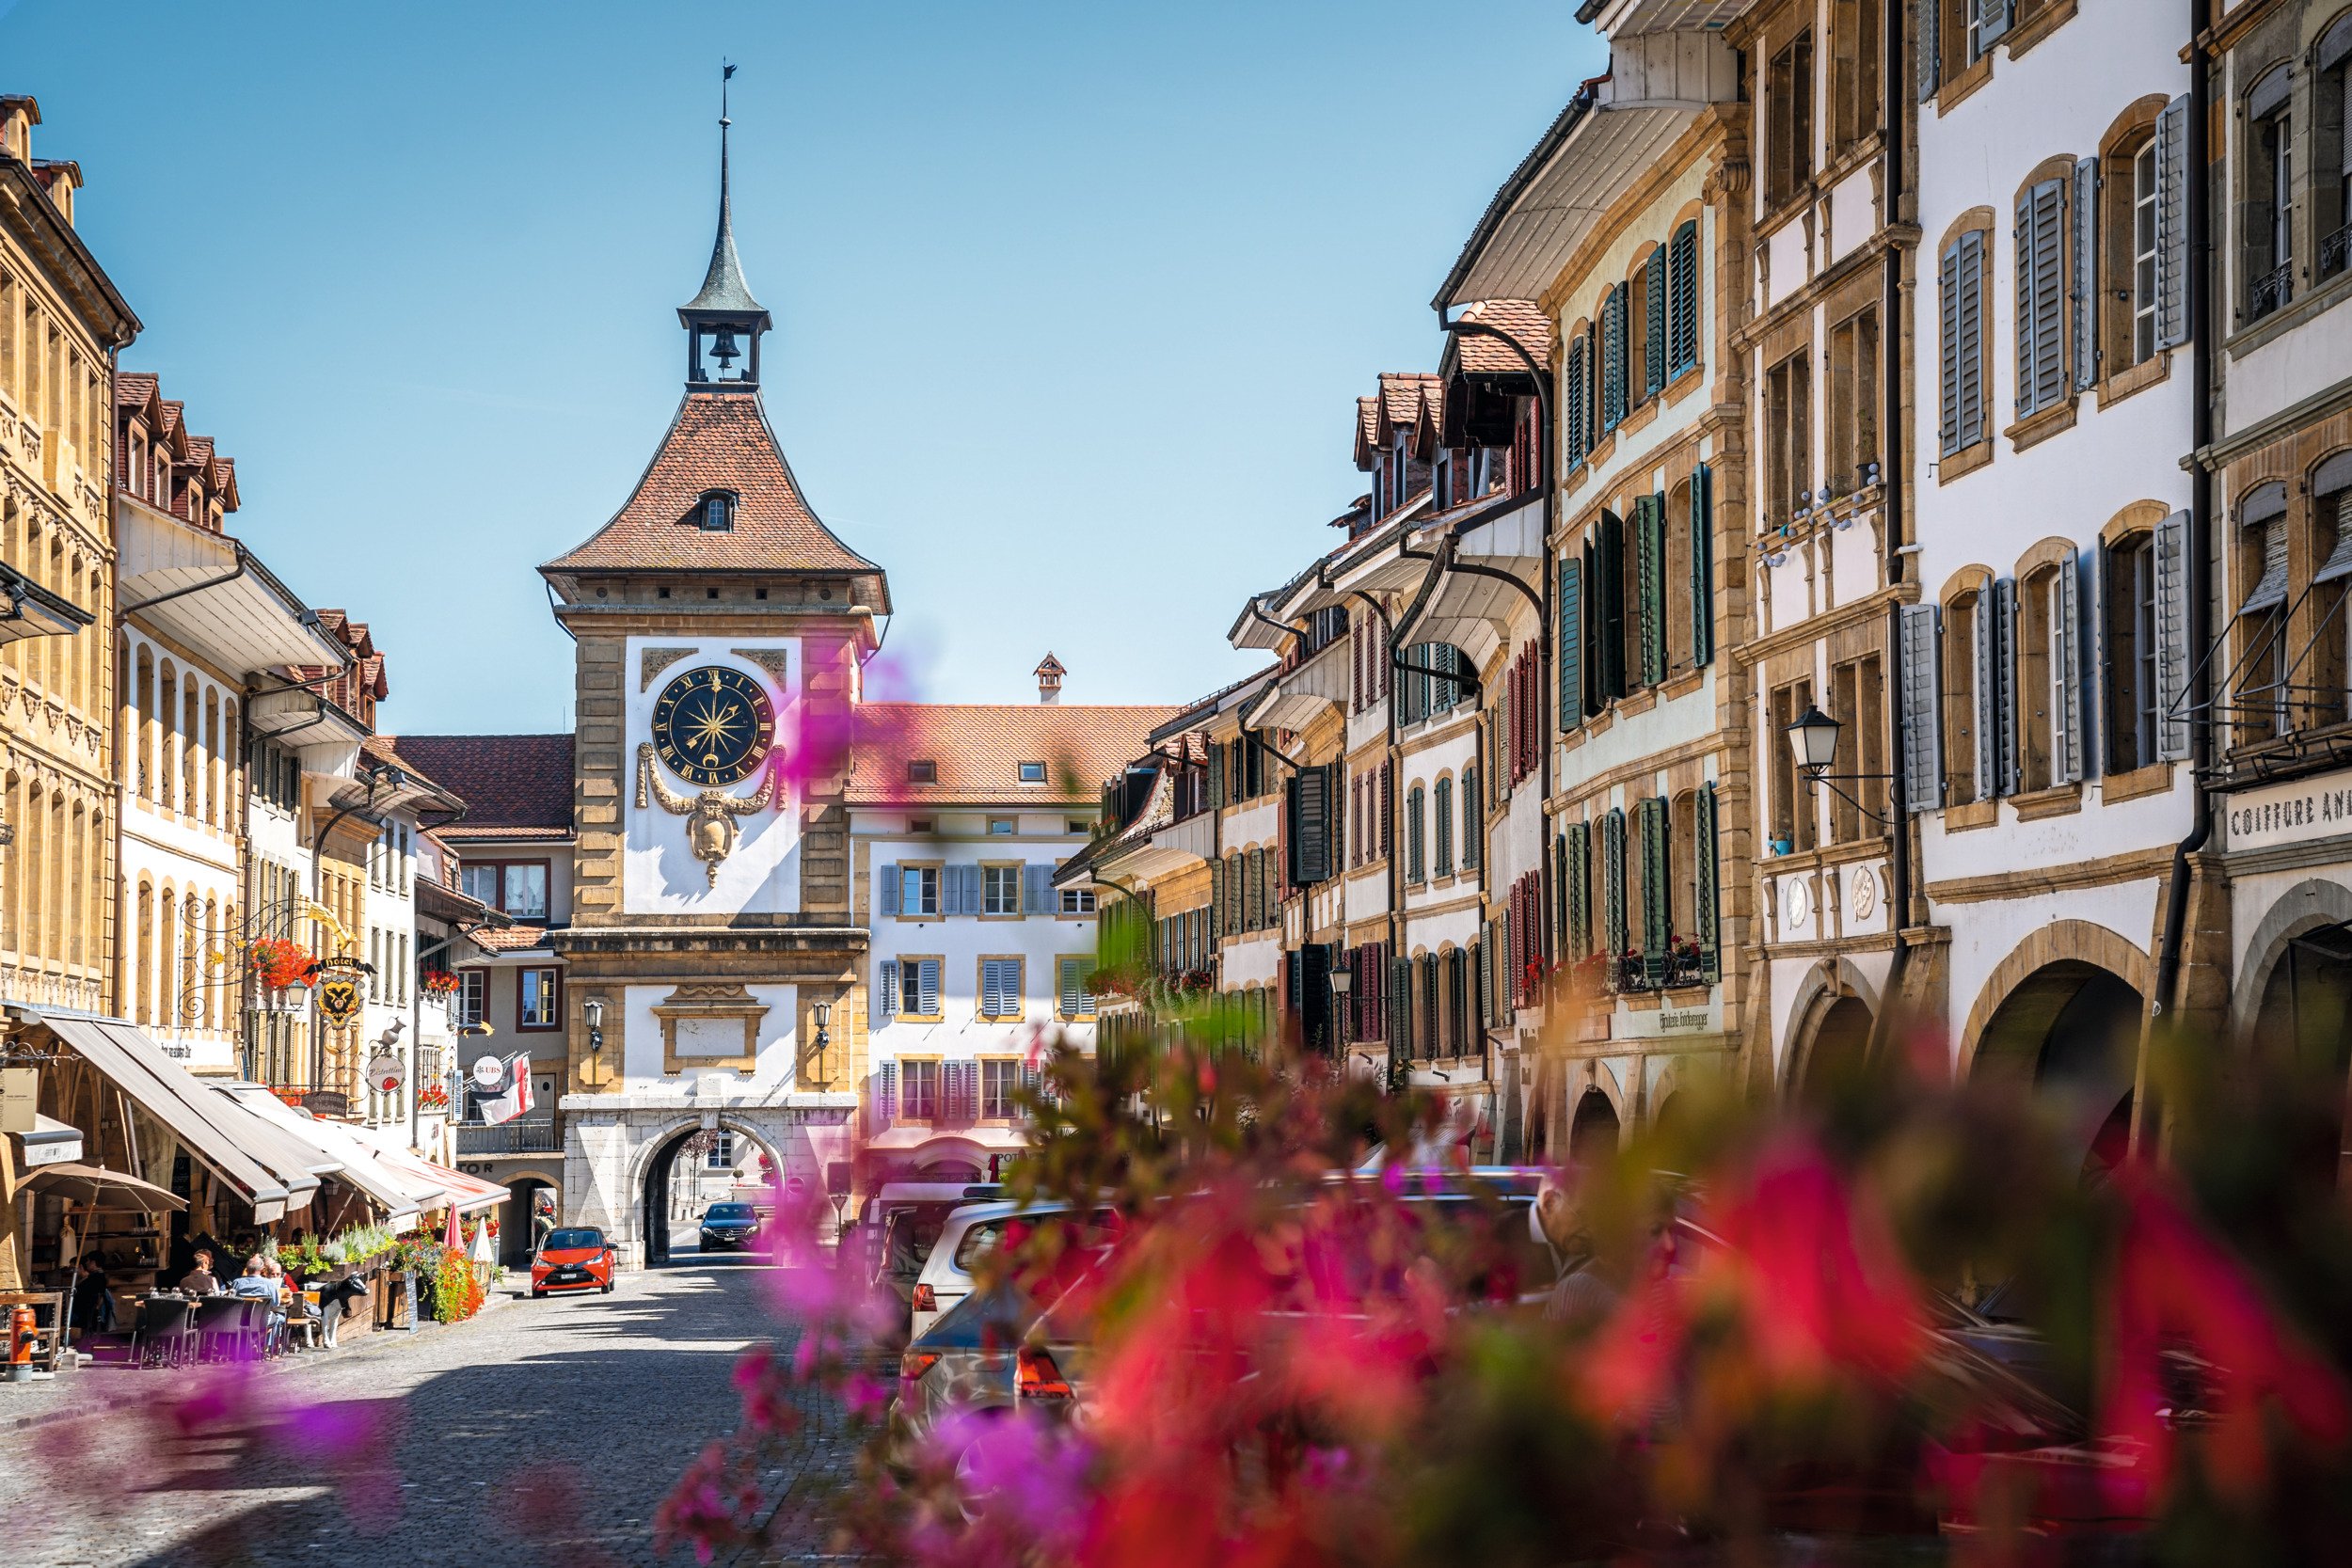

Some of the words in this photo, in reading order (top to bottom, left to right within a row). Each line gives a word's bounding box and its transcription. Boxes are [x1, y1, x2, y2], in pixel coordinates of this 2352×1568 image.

[680, 675, 694, 689] XI
[660, 696, 675, 707] X
[753, 696, 765, 706] II
[759, 722, 771, 731] III
[736, 766, 746, 778] V
[2231, 797, 2314, 836] COIFFURE
